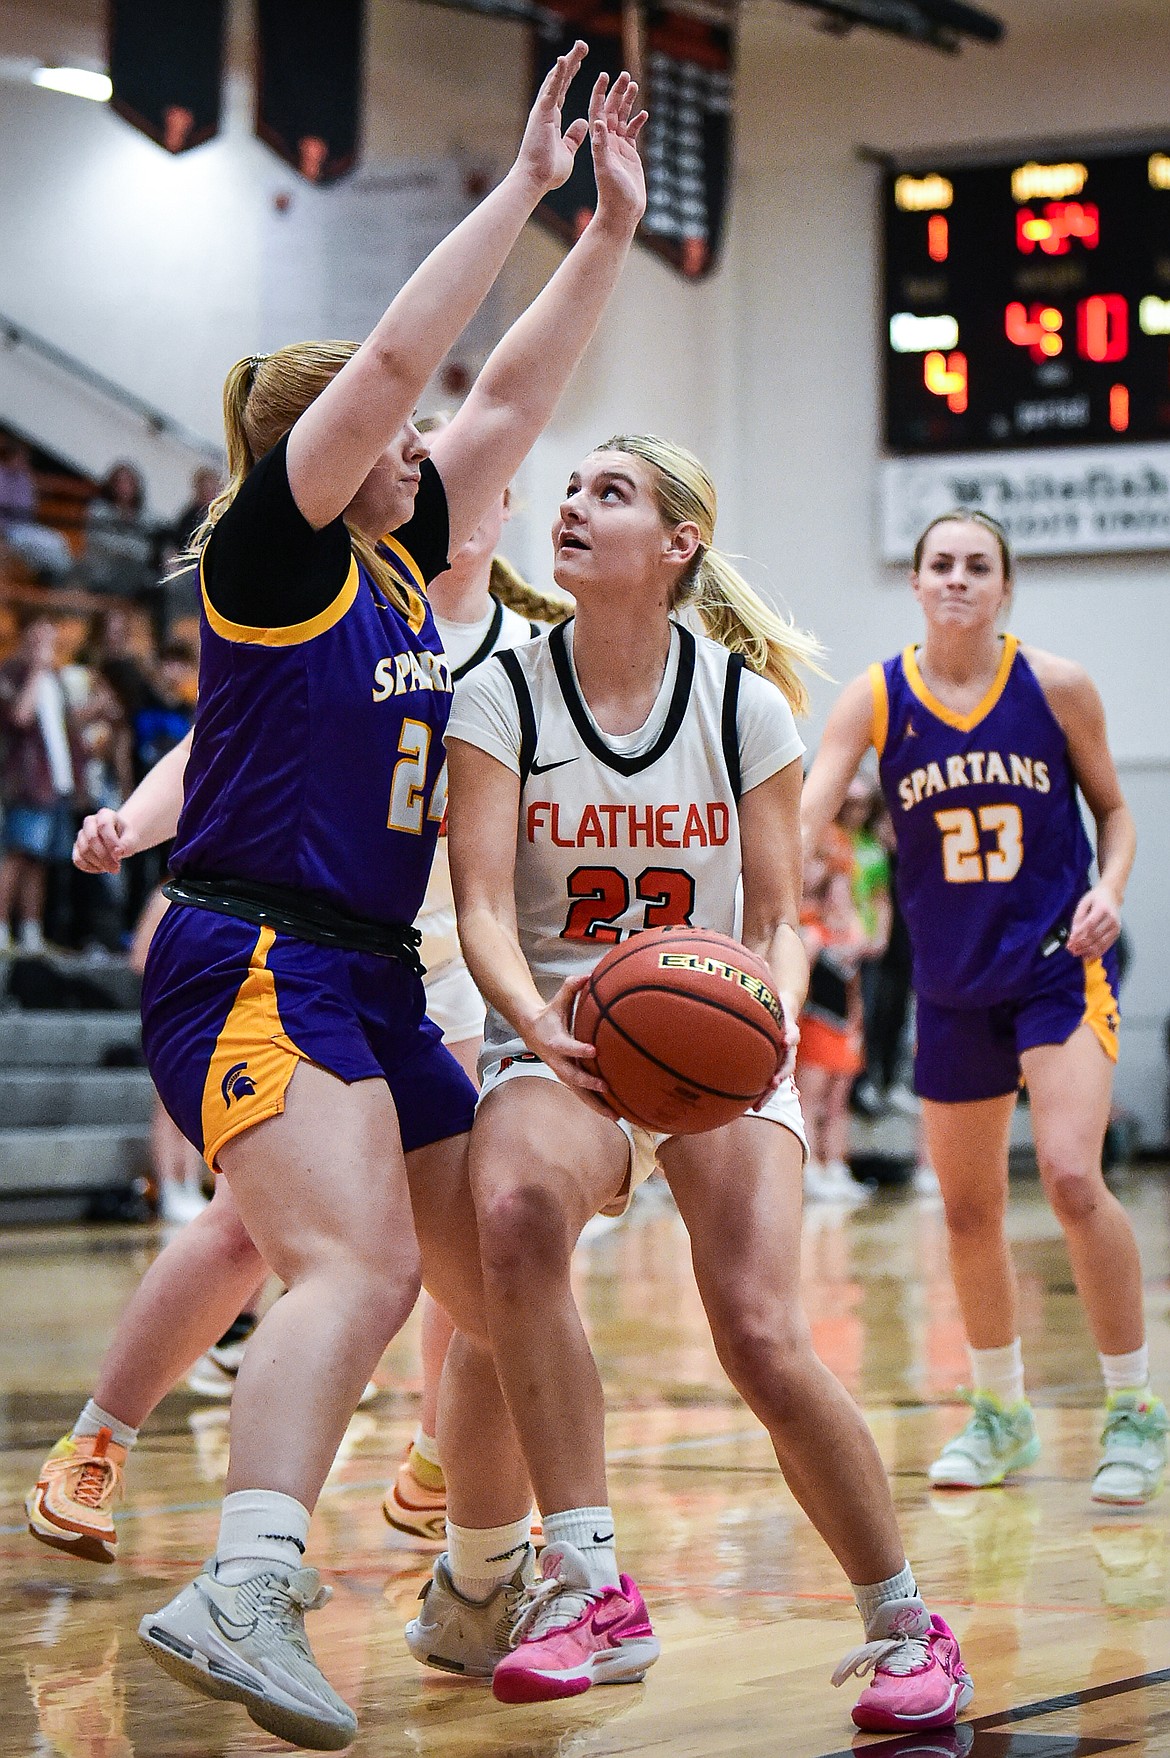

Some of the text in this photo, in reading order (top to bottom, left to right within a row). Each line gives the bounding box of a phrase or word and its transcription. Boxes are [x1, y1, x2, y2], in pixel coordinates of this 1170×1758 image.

[898, 751, 1050, 811] SPARTANS
[527, 801, 730, 848] FLATHEAD
[933, 803, 1024, 884] 23
[559, 865, 696, 944] 23
